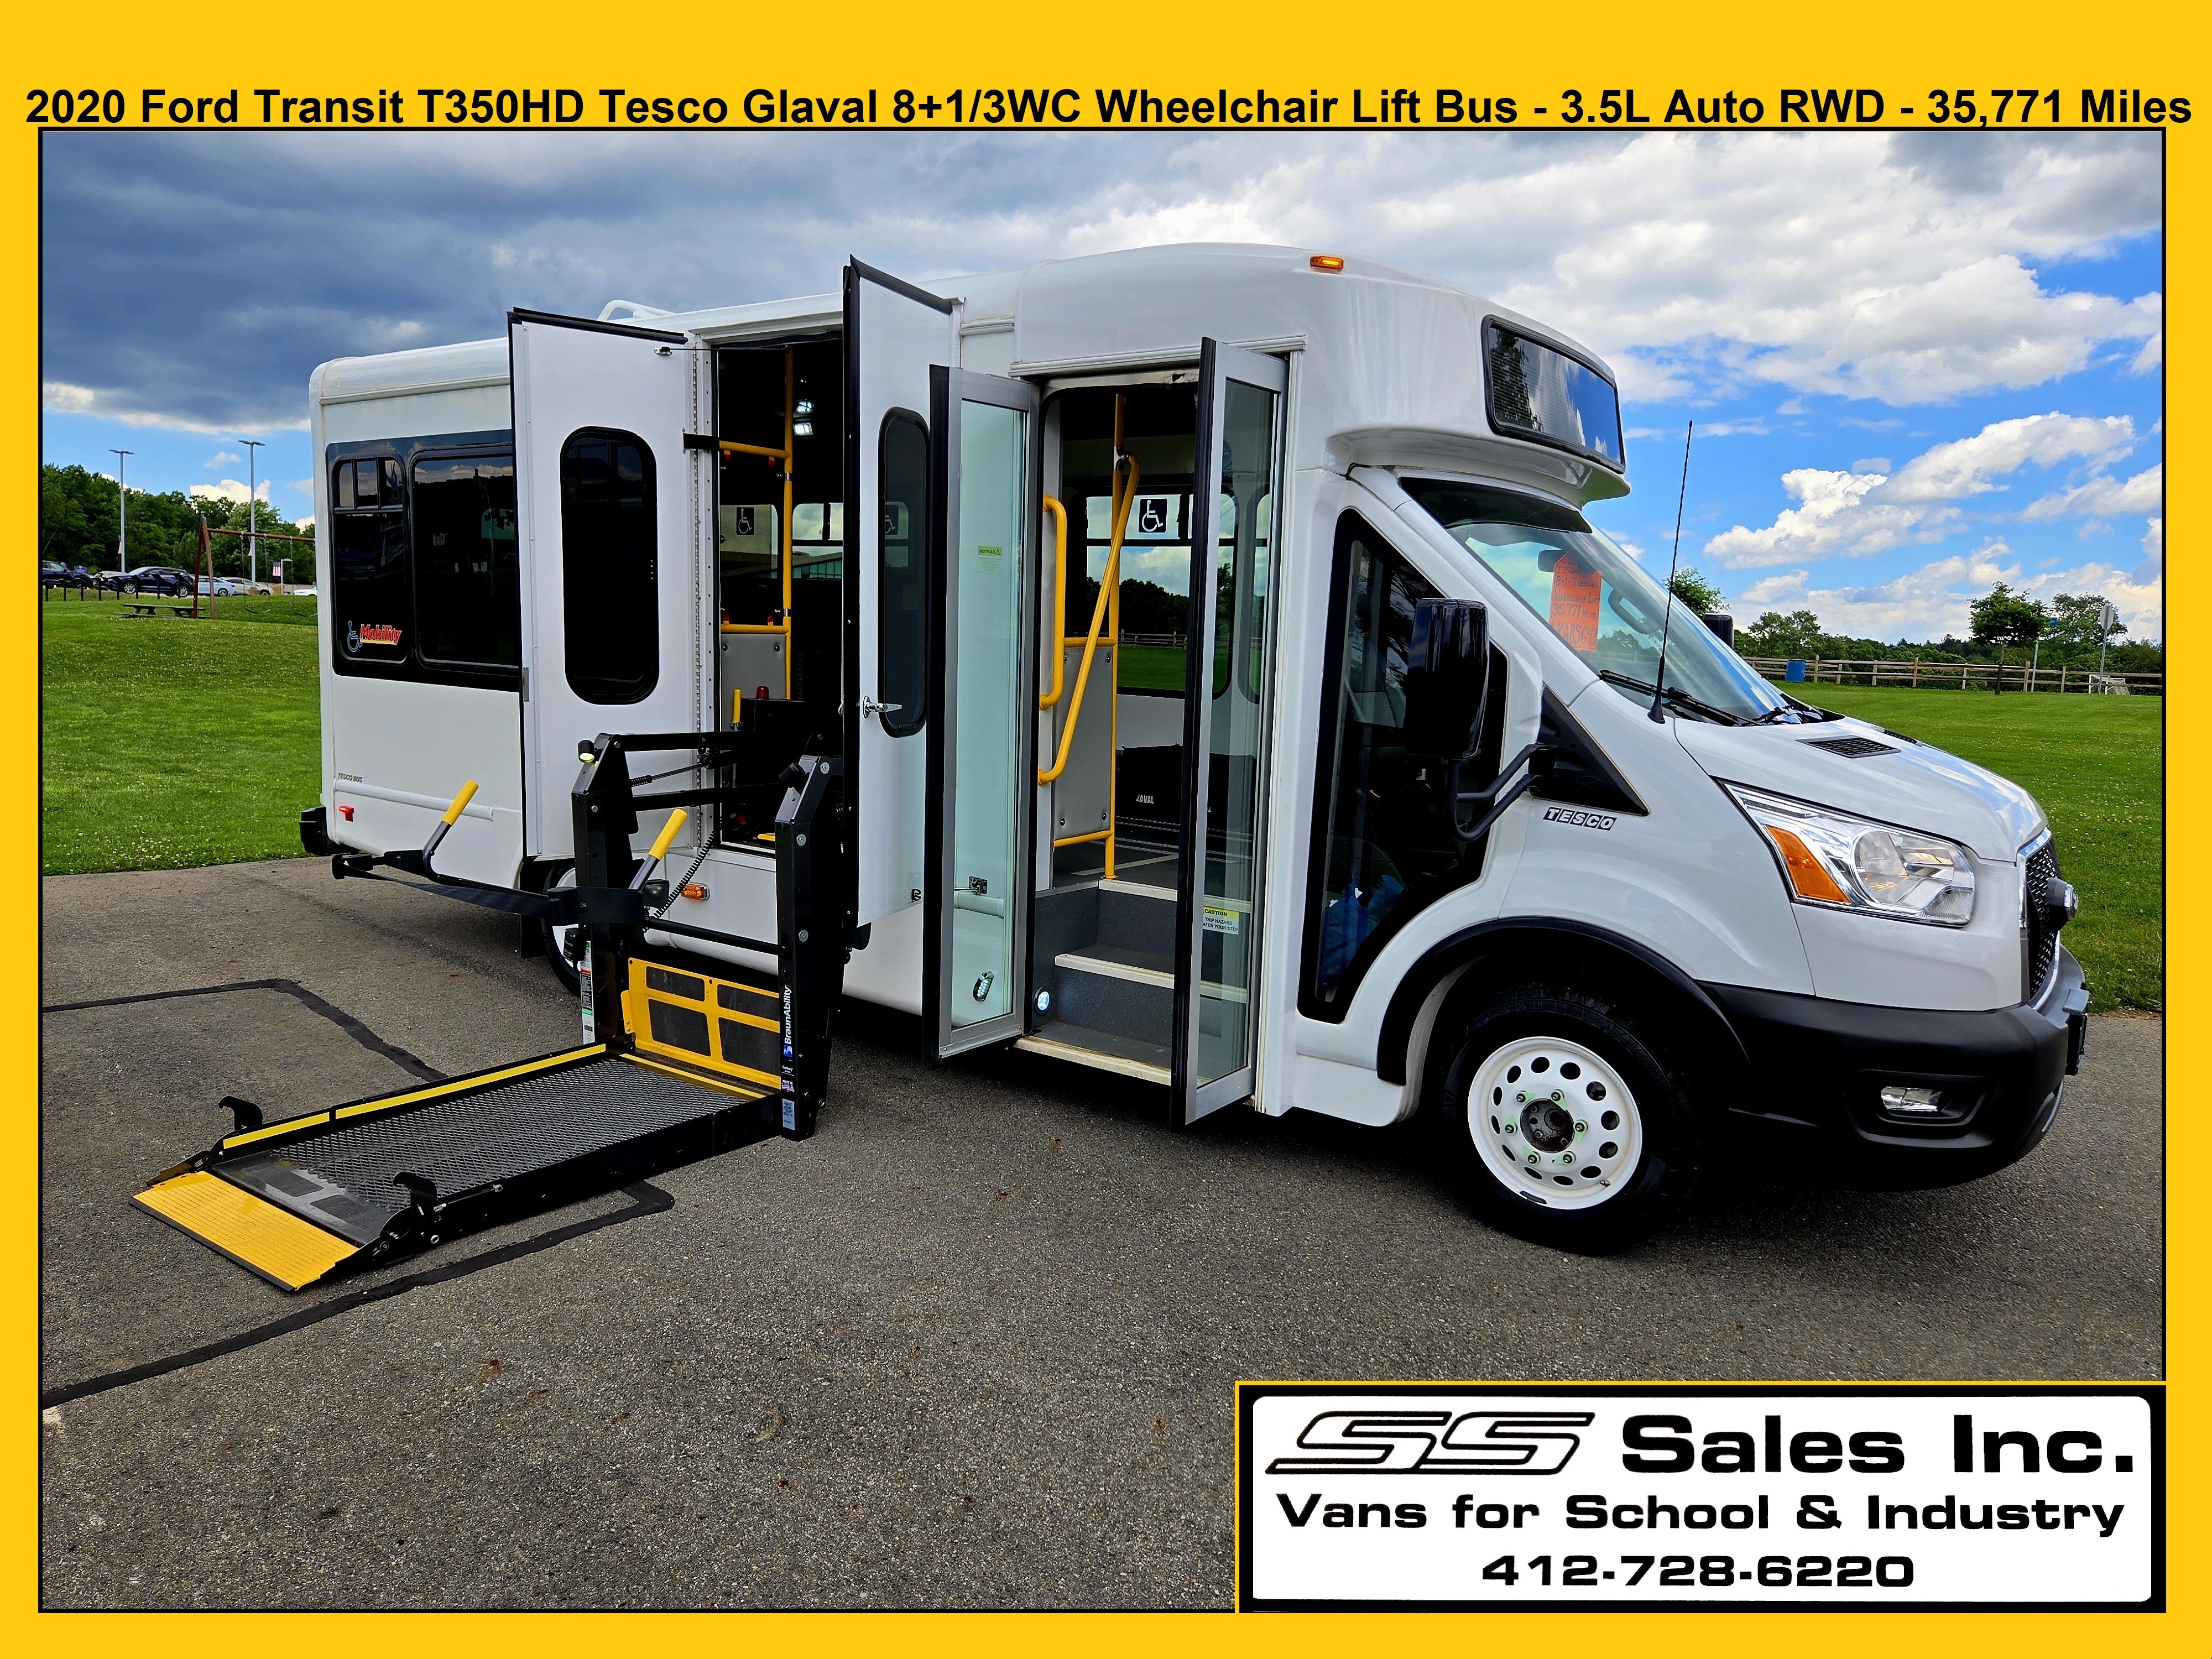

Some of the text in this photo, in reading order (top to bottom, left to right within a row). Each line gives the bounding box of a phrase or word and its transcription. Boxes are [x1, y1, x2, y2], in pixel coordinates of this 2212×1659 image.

[1552, 603, 1581, 618] 35,771
[359, 624, 402, 645] Mobility
[338, 773, 352, 781] TESCO
[1546, 807, 1615, 830] TESCO
[783, 984, 792, 1045] BraunAbility
